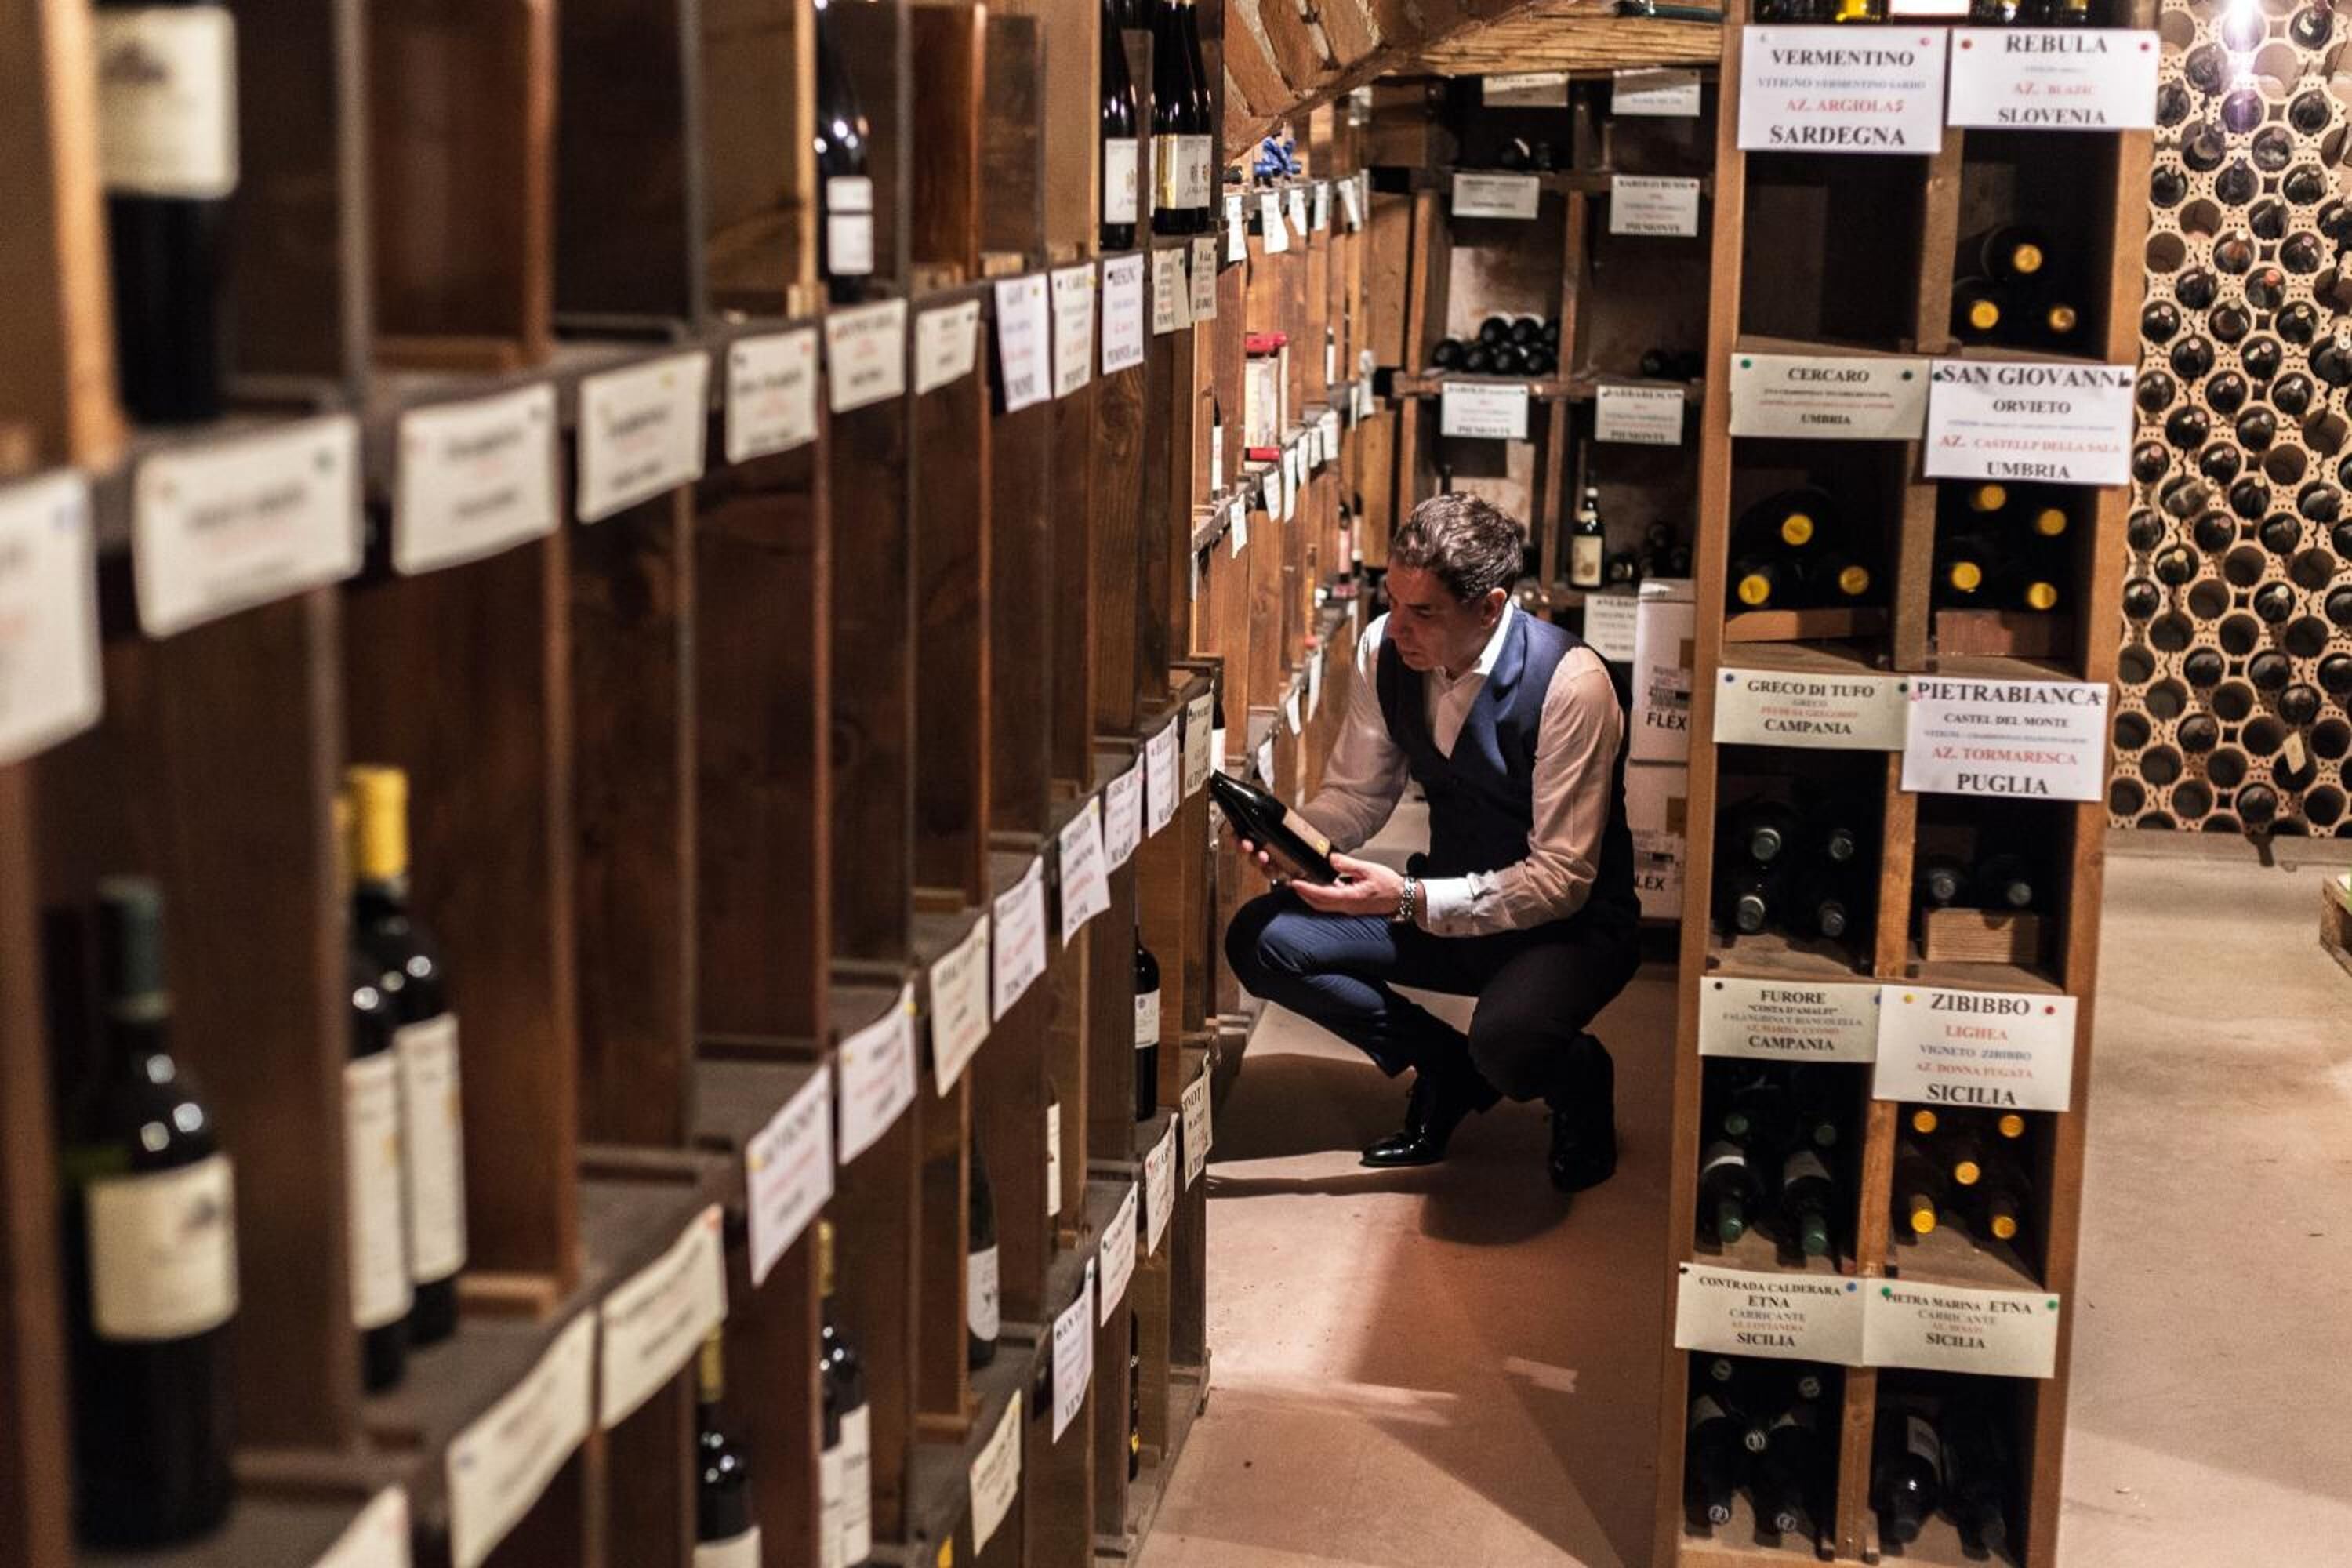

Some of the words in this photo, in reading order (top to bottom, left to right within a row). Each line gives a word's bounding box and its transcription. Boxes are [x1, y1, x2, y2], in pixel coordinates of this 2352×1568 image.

[2005, 34, 2107, 53] REBULA
[1771, 49, 1915, 67] VERMENTINO
[1998, 108, 2106, 125] SLOVENIA
[1769, 125, 1905, 145] SARDEGNA
[1788, 367, 1870, 383] CERCARO
[1943, 365, 1991, 384] SAN
[1993, 400, 2071, 415] ORVIETO
[1801, 413, 1851, 426] UMBRIA
[1987, 462, 2071, 479] UMBRIA
[1748, 680, 1805, 695] GRECO
[1809, 684, 1825, 696] DI
[1831, 684, 1875, 698] TUFO
[1918, 682, 2100, 706] PIETRABIANCA
[1646, 712, 1687, 731] FLEX
[1765, 719, 1852, 735] CAMPANIA
[1944, 713, 1991, 724] CASTEL
[1996, 715, 2018, 725] DEL
[2024, 717, 2068, 728] MONTE
[1964, 748, 2078, 765] TORMARESCA
[1958, 774, 2049, 794] PUGLIA
[1635, 874, 1666, 891] LEX
[1761, 990, 1826, 1004] FURORE
[1931, 993, 2030, 1016] ZIBIBBO
[1946, 1025, 2008, 1040] LIGHEA
[1748, 1036, 1835, 1051] CAMPANIA
[1920, 1044, 1976, 1058] VIGNETO
[1927, 1083, 2017, 1106] SICILIA
[1699, 1277, 1764, 1293] CONTRADA
[1767, 1283, 1842, 1297] CALDERARA
[1748, 1295, 1791, 1308] ETNA
[1933, 1298, 1982, 1312] MARINA
[1990, 1301, 2032, 1315] ETNA
[1729, 1308, 1806, 1322] CARRICANTE
[1918, 1309, 1996, 1325] CARRICANTE
[1737, 1333, 1796, 1347] SICILIA
[1926, 1333, 1985, 1348] SICILIA
